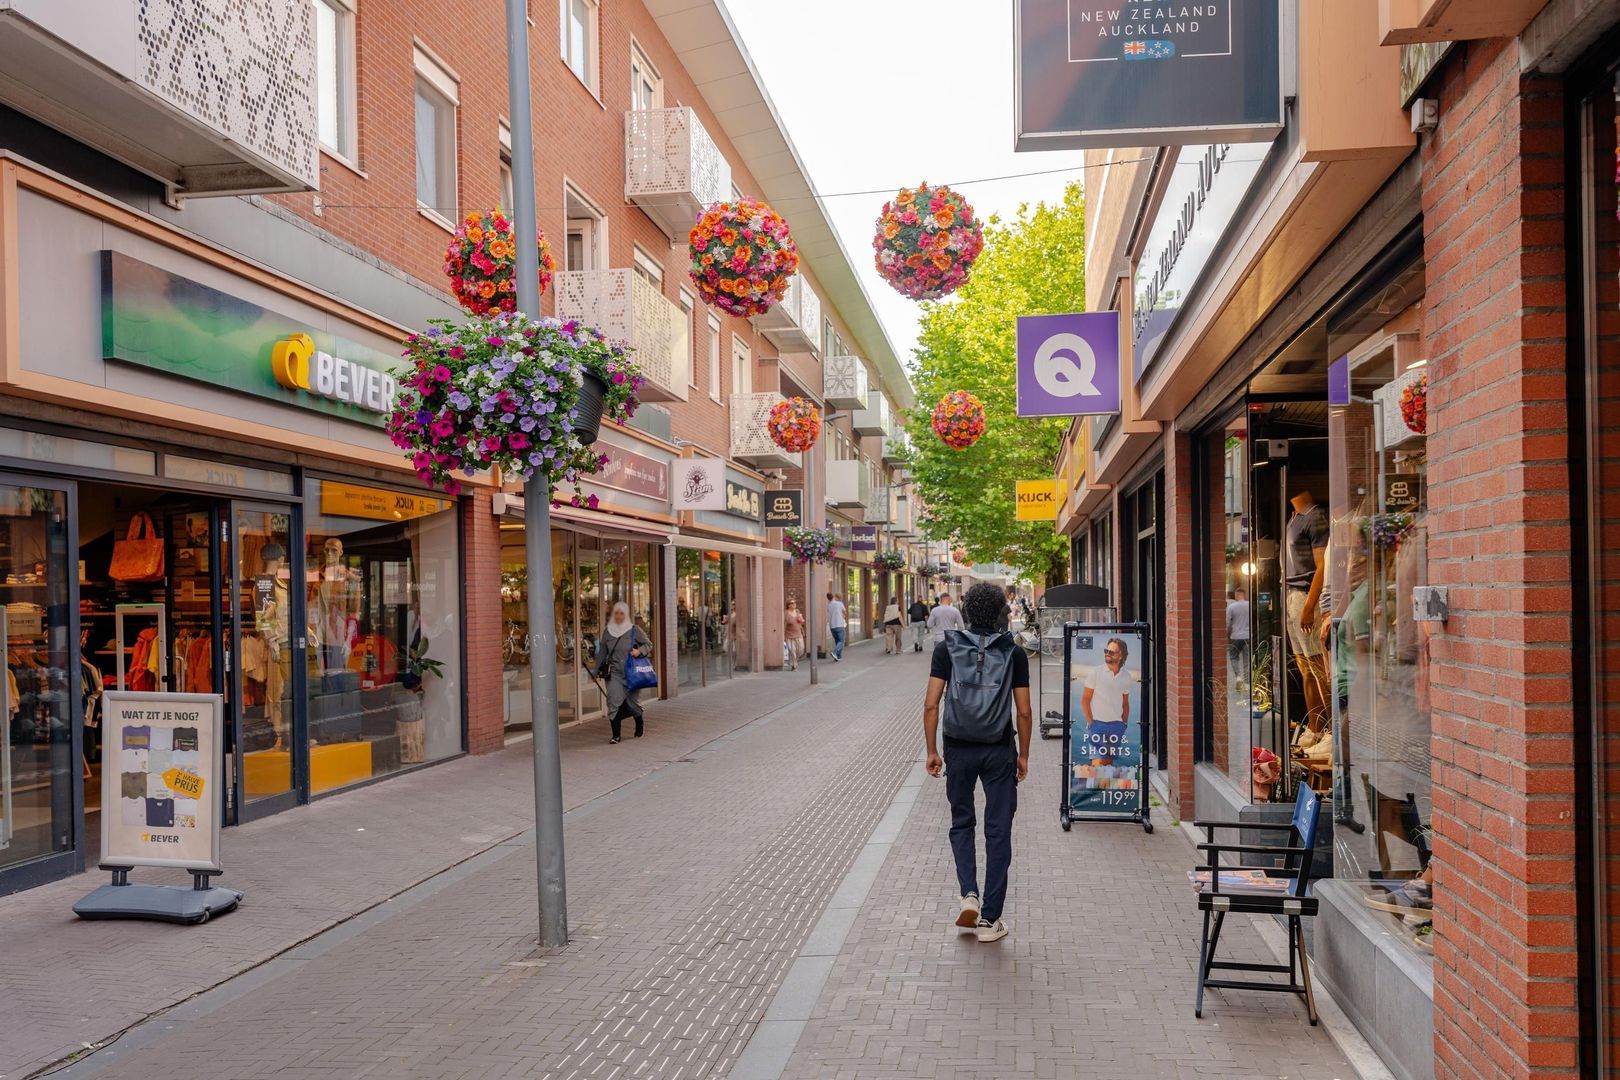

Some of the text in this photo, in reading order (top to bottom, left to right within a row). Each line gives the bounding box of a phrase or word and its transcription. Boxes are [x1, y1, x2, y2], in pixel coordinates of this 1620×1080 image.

[1081, 5, 1217, 22] NEW ZEALAND
[1098, 21, 1200, 37] AUCKLAND
[311, 350, 396, 413] BEVER
[1018, 492, 1056, 502] KIJCK.
[122, 710, 200, 721] WAT ZIT JE NOG?
[1081, 745, 1131, 756] SHORTS
[174, 777, 199, 794] PRIJS
[150, 834, 180, 844] BEVER
